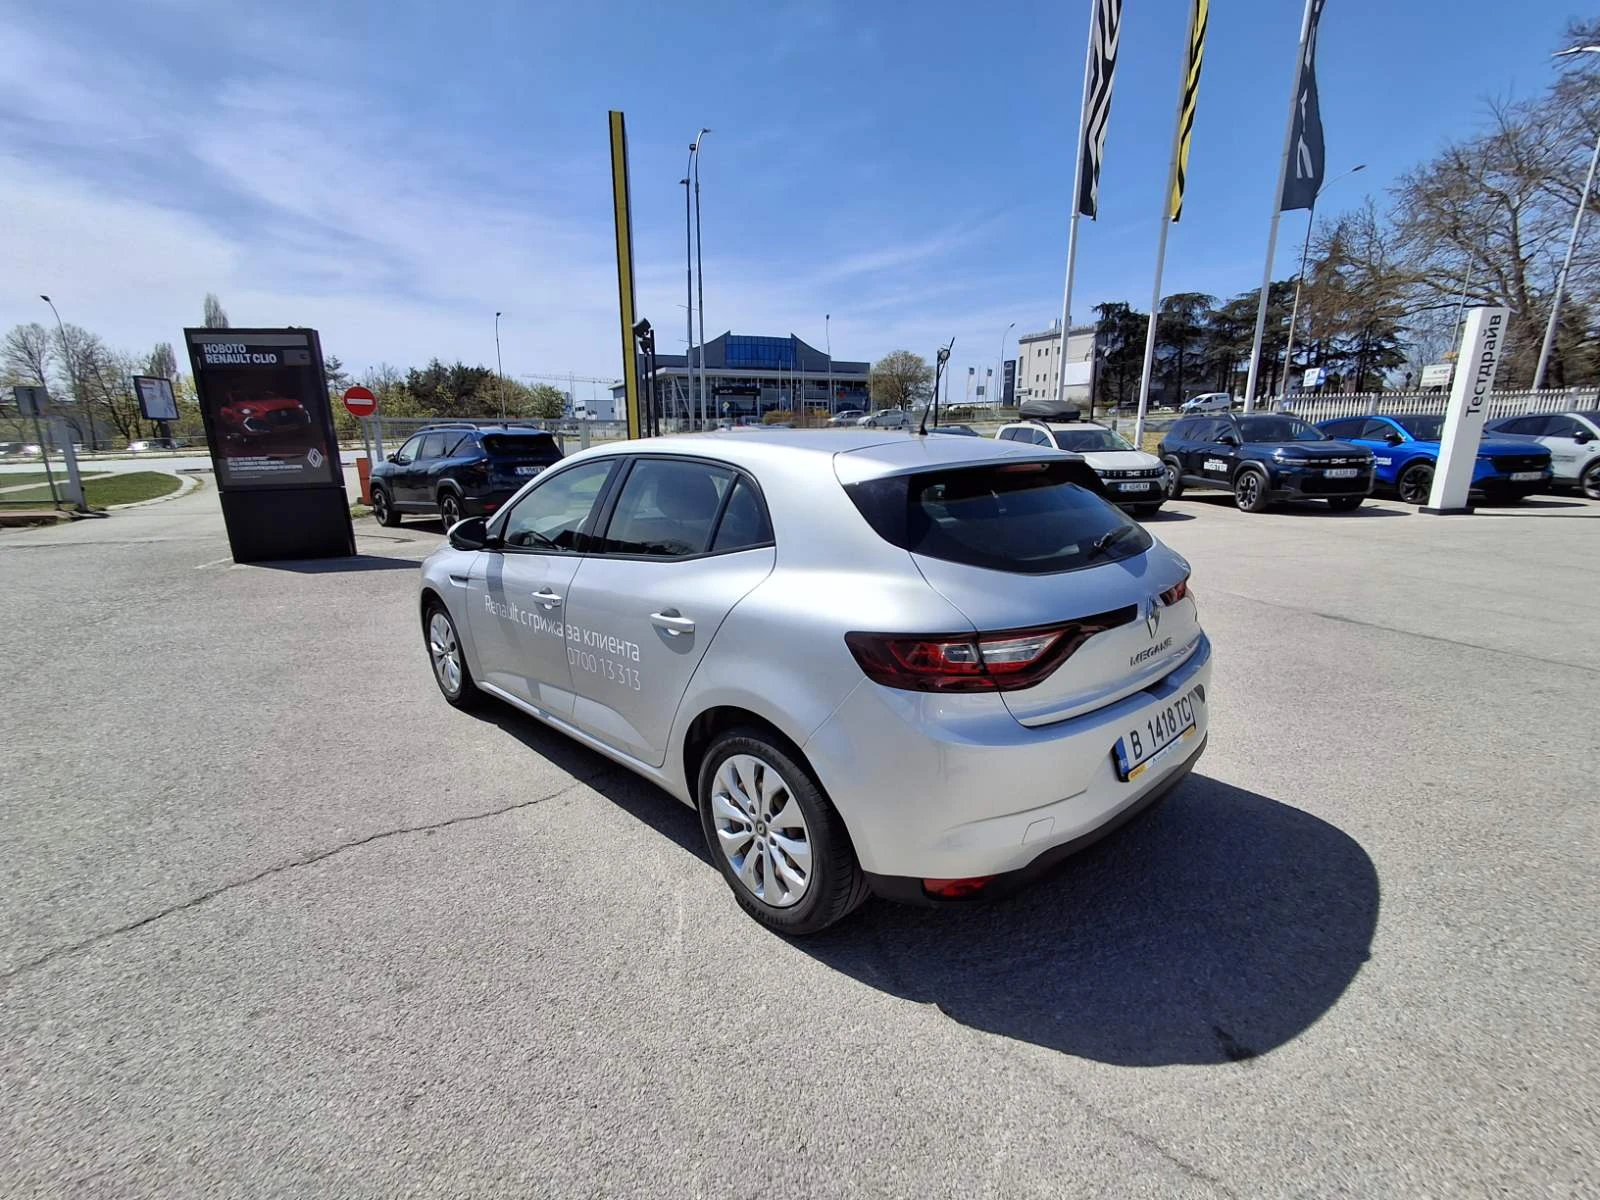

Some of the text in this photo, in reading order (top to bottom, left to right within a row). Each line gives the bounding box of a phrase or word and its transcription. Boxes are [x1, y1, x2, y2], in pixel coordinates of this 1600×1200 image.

[203, 343, 247, 354] НОВОТО
[206, 353, 278, 364] RENAULT CLIO
[1465, 314, 1502, 418] Тестдрайв
[484, 594, 520, 623] Renault
[528, 612, 565, 638] грижа
[566, 623, 582, 642] за
[583, 628, 641, 662] клиента
[567, 646, 598, 673] 0700
[617, 663, 642, 692] 313
[1129, 636, 1174, 667] MEGANE
[1130, 729, 1143, 760] B
[1147, 706, 1177, 748] 1418
[1174, 695, 1191, 726] TC
